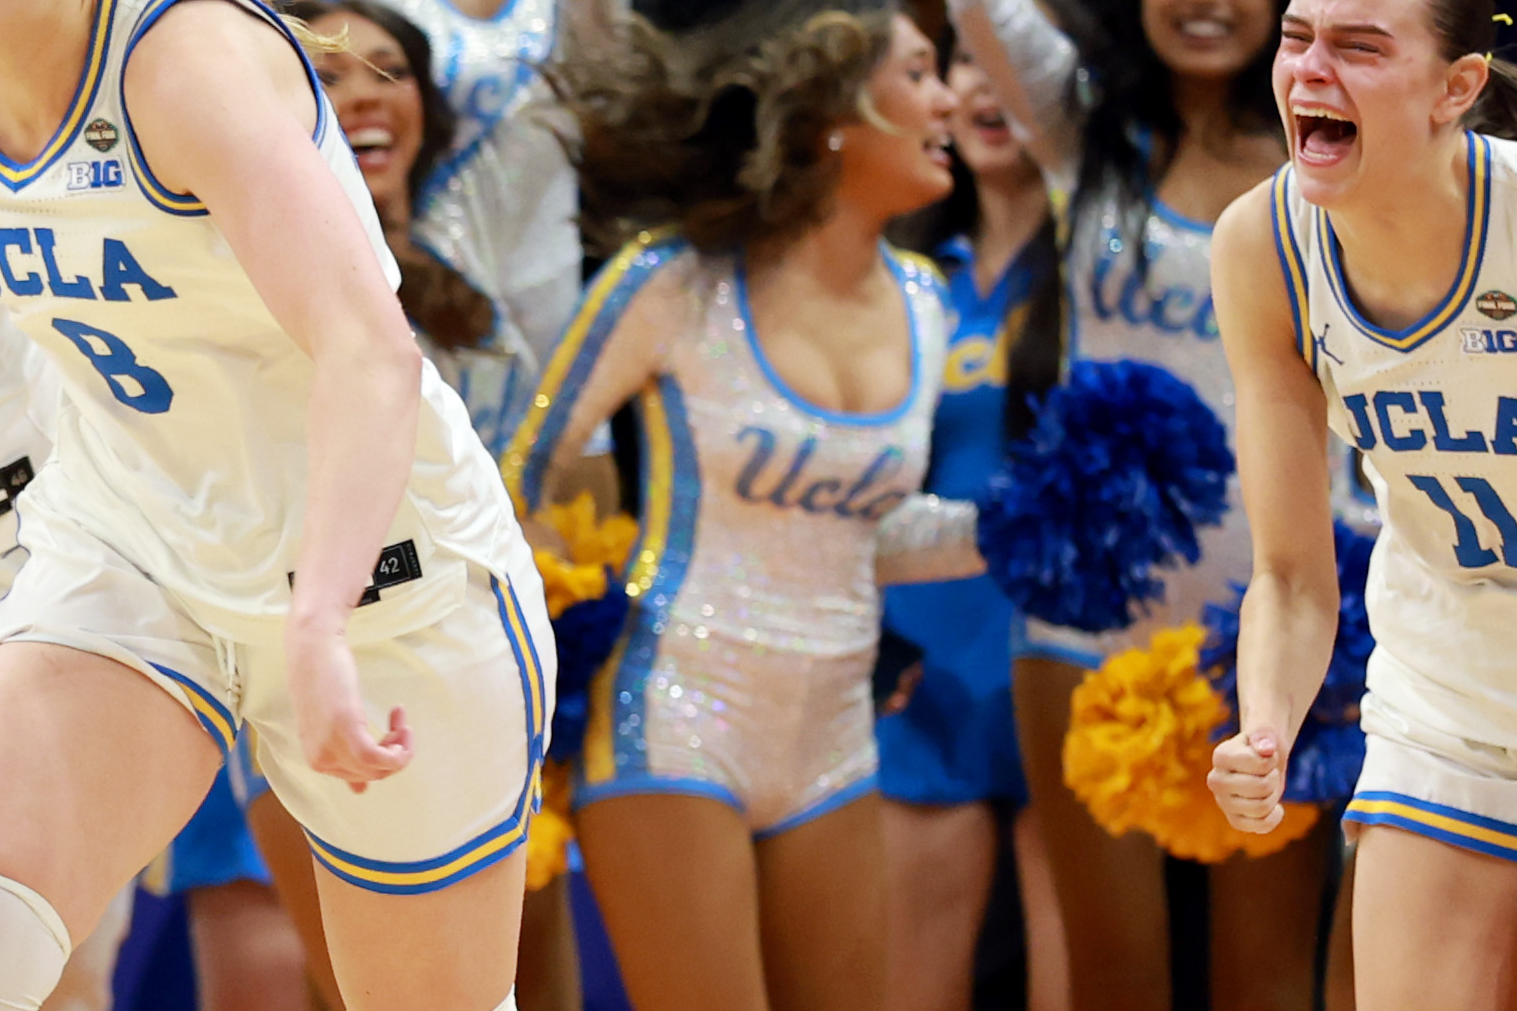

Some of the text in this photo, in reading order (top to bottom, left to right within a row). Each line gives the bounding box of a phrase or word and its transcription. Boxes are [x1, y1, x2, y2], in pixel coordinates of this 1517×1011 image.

[51, 317, 175, 415] 8
[380, 556, 400, 575] 42
[1405, 474, 1517, 568] 11
